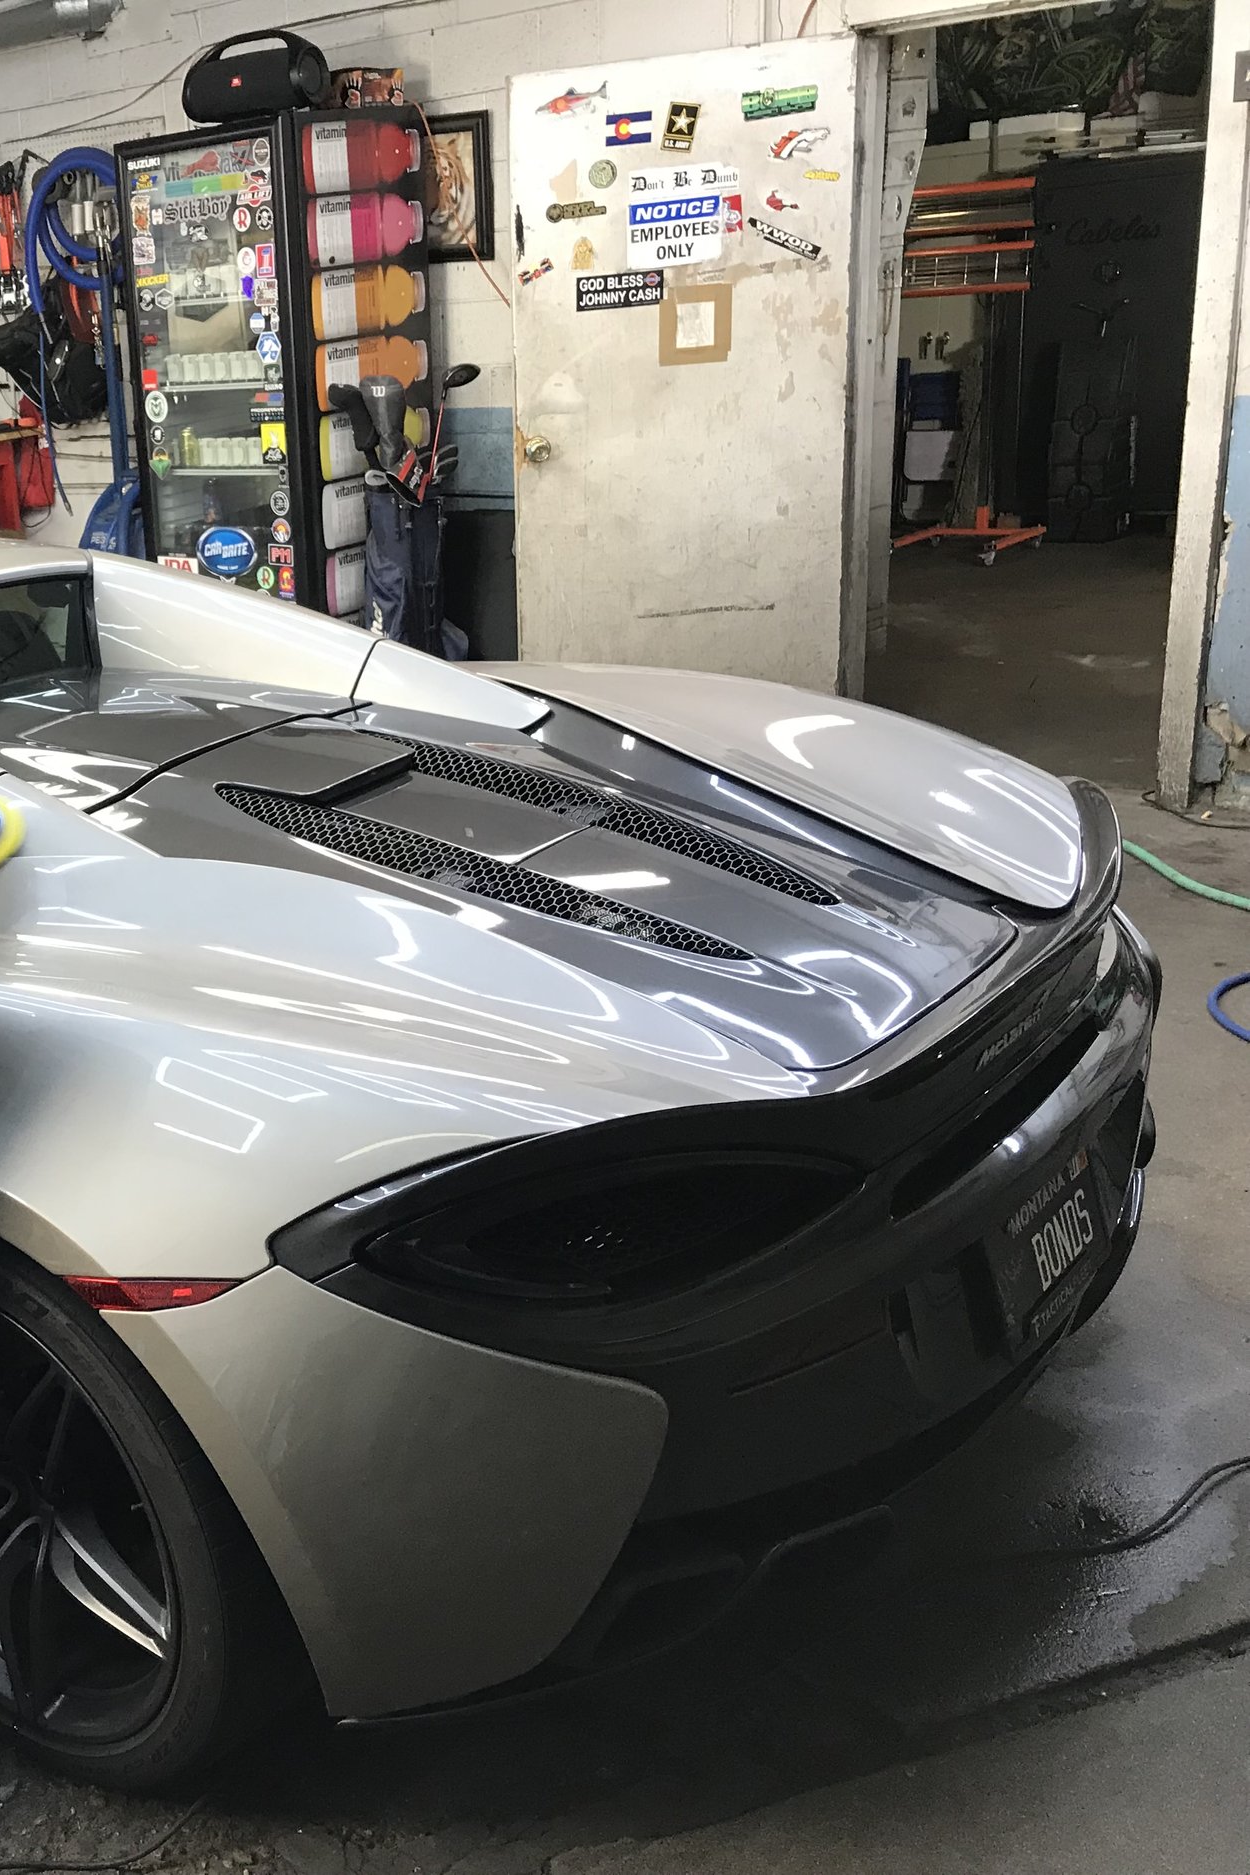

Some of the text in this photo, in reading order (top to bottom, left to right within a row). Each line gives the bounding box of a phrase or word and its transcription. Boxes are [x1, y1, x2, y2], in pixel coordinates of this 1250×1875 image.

[127, 157, 161, 171] SUZUKI
[635, 199, 716, 221] NOTICE
[631, 220, 719, 244] EMPLOYEES
[757, 220, 813, 251] WWOD
[656, 243, 694, 260] ONLY
[579, 274, 644, 292] GOD BLESS
[579, 290, 626, 307] JOHNNY
[628, 287, 661, 302] CASH
[1007, 1171, 1067, 1239] MONTANA
[1031, 1187, 1095, 1293] BONDS
